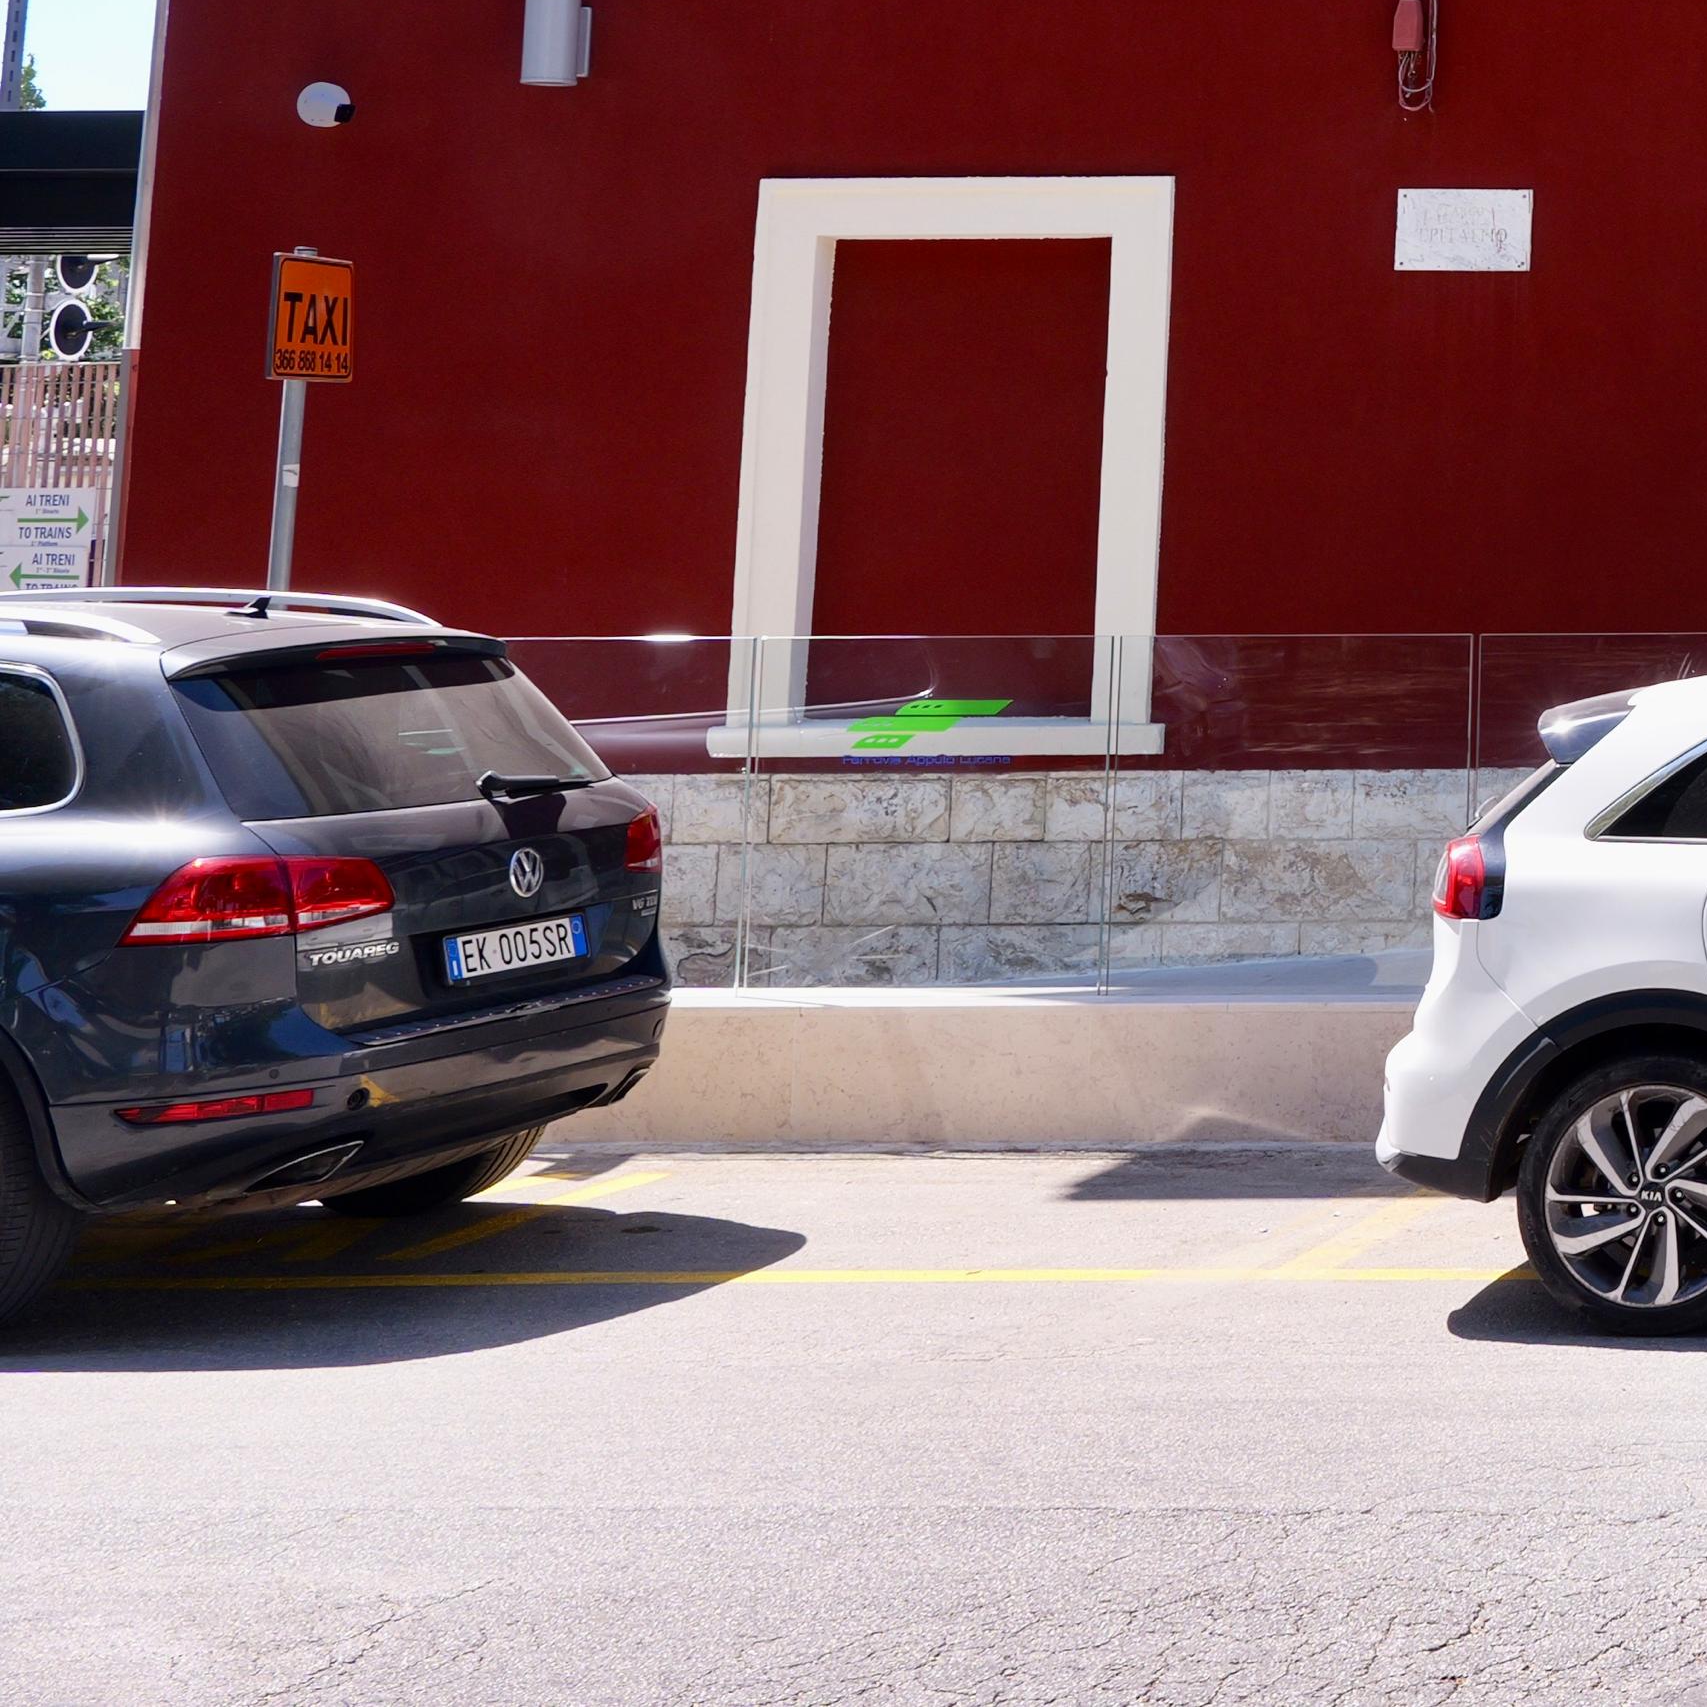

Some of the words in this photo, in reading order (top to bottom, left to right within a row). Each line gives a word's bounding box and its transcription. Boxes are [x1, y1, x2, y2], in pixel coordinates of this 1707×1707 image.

[284, 291, 348, 346] TAXI
[275, 348, 296, 371] 366
[319, 352, 332, 373] 14
[335, 352, 349, 374] 14
[25, 494, 37, 506] AI
[40, 494, 70, 506] TRENI
[19, 526, 32, 539] TO
[34, 526, 72, 539] TRAINS
[32, 553, 43, 565] AI
[46, 553, 75, 565] TRENI
[905, 754, 955, 766] Appulo
[309, 941, 400, 967] TOUAREG
[461, 936, 492, 974] EK
[499, 923, 572, 966] 005SR
[1640, 1190, 1663, 1202] KIA
